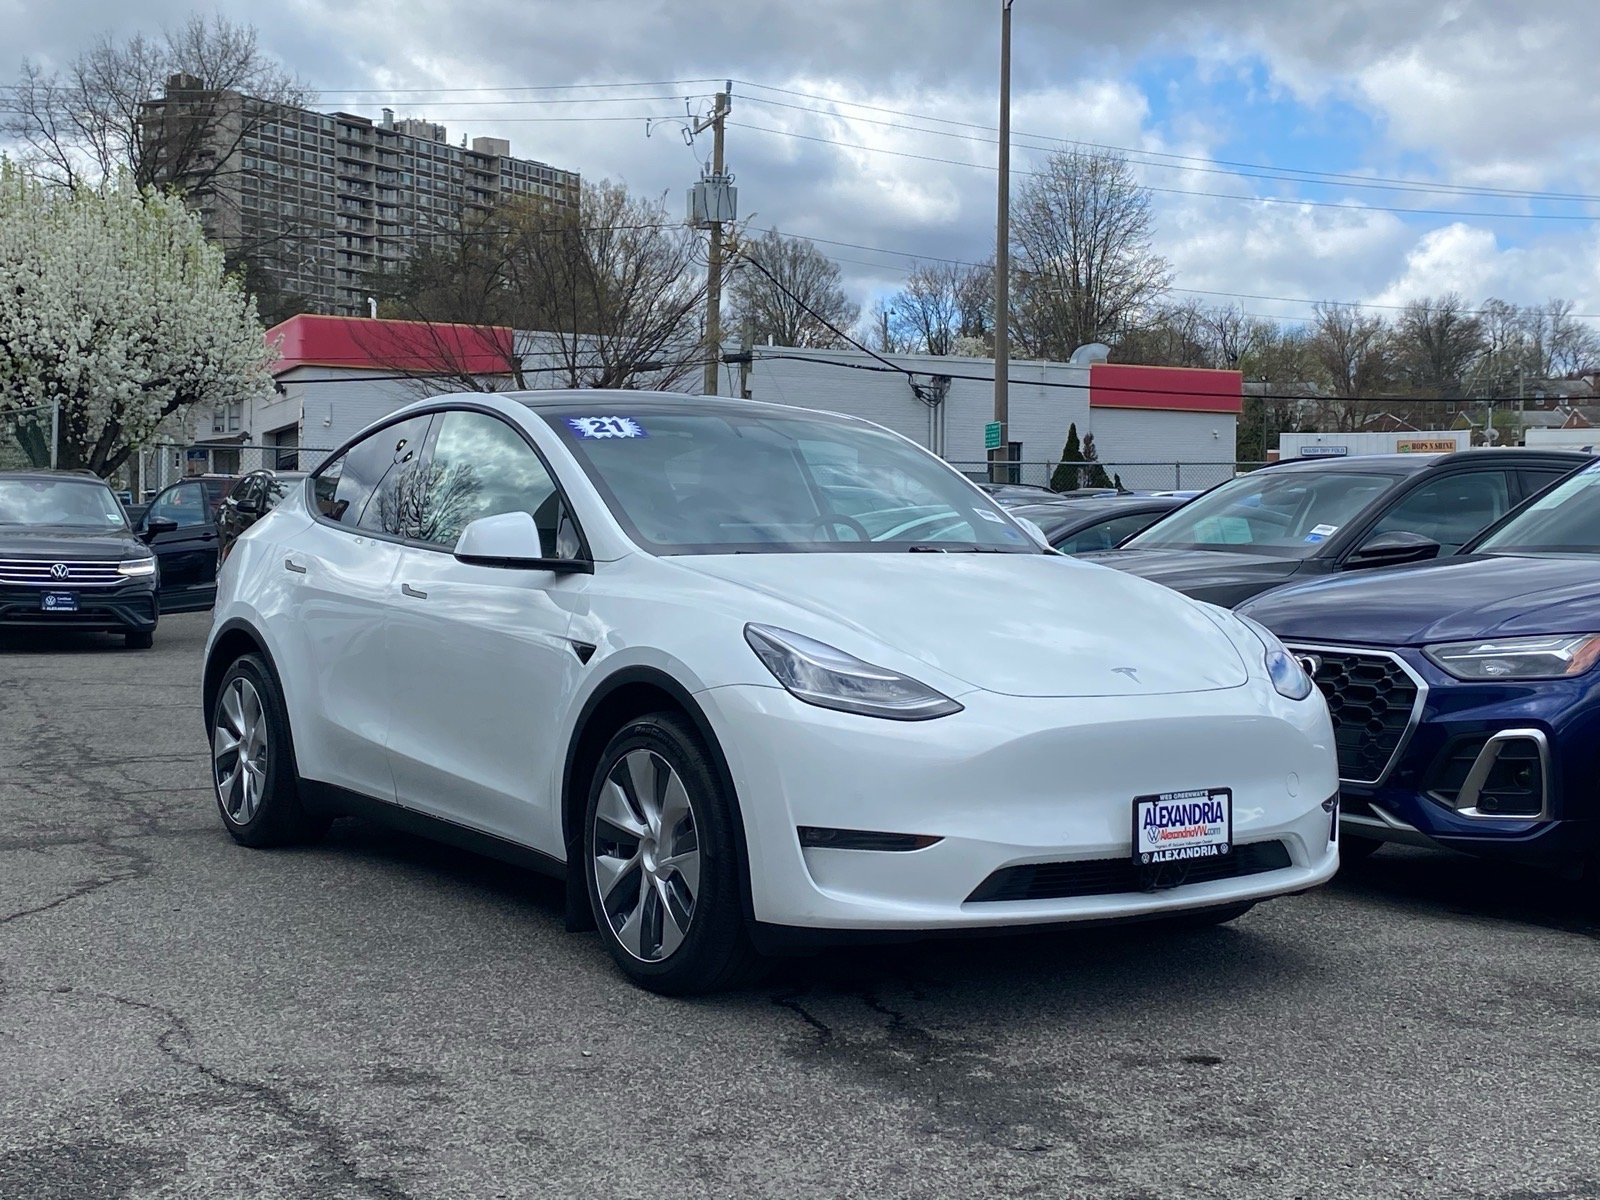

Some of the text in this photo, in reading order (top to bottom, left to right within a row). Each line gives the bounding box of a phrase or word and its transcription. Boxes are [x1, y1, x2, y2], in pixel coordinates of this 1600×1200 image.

[589, 420, 624, 432] 21
[1411, 442, 1428, 450] HOPS
[1434, 441, 1453, 449] SHINE
[1173, 790, 1209, 799] GREENWAY'S
[1143, 801, 1224, 829] ALEXANDRIA
[1160, 825, 1221, 840] AlexandriaVW.com
[1152, 845, 1218, 862] ALEXANDRIA
